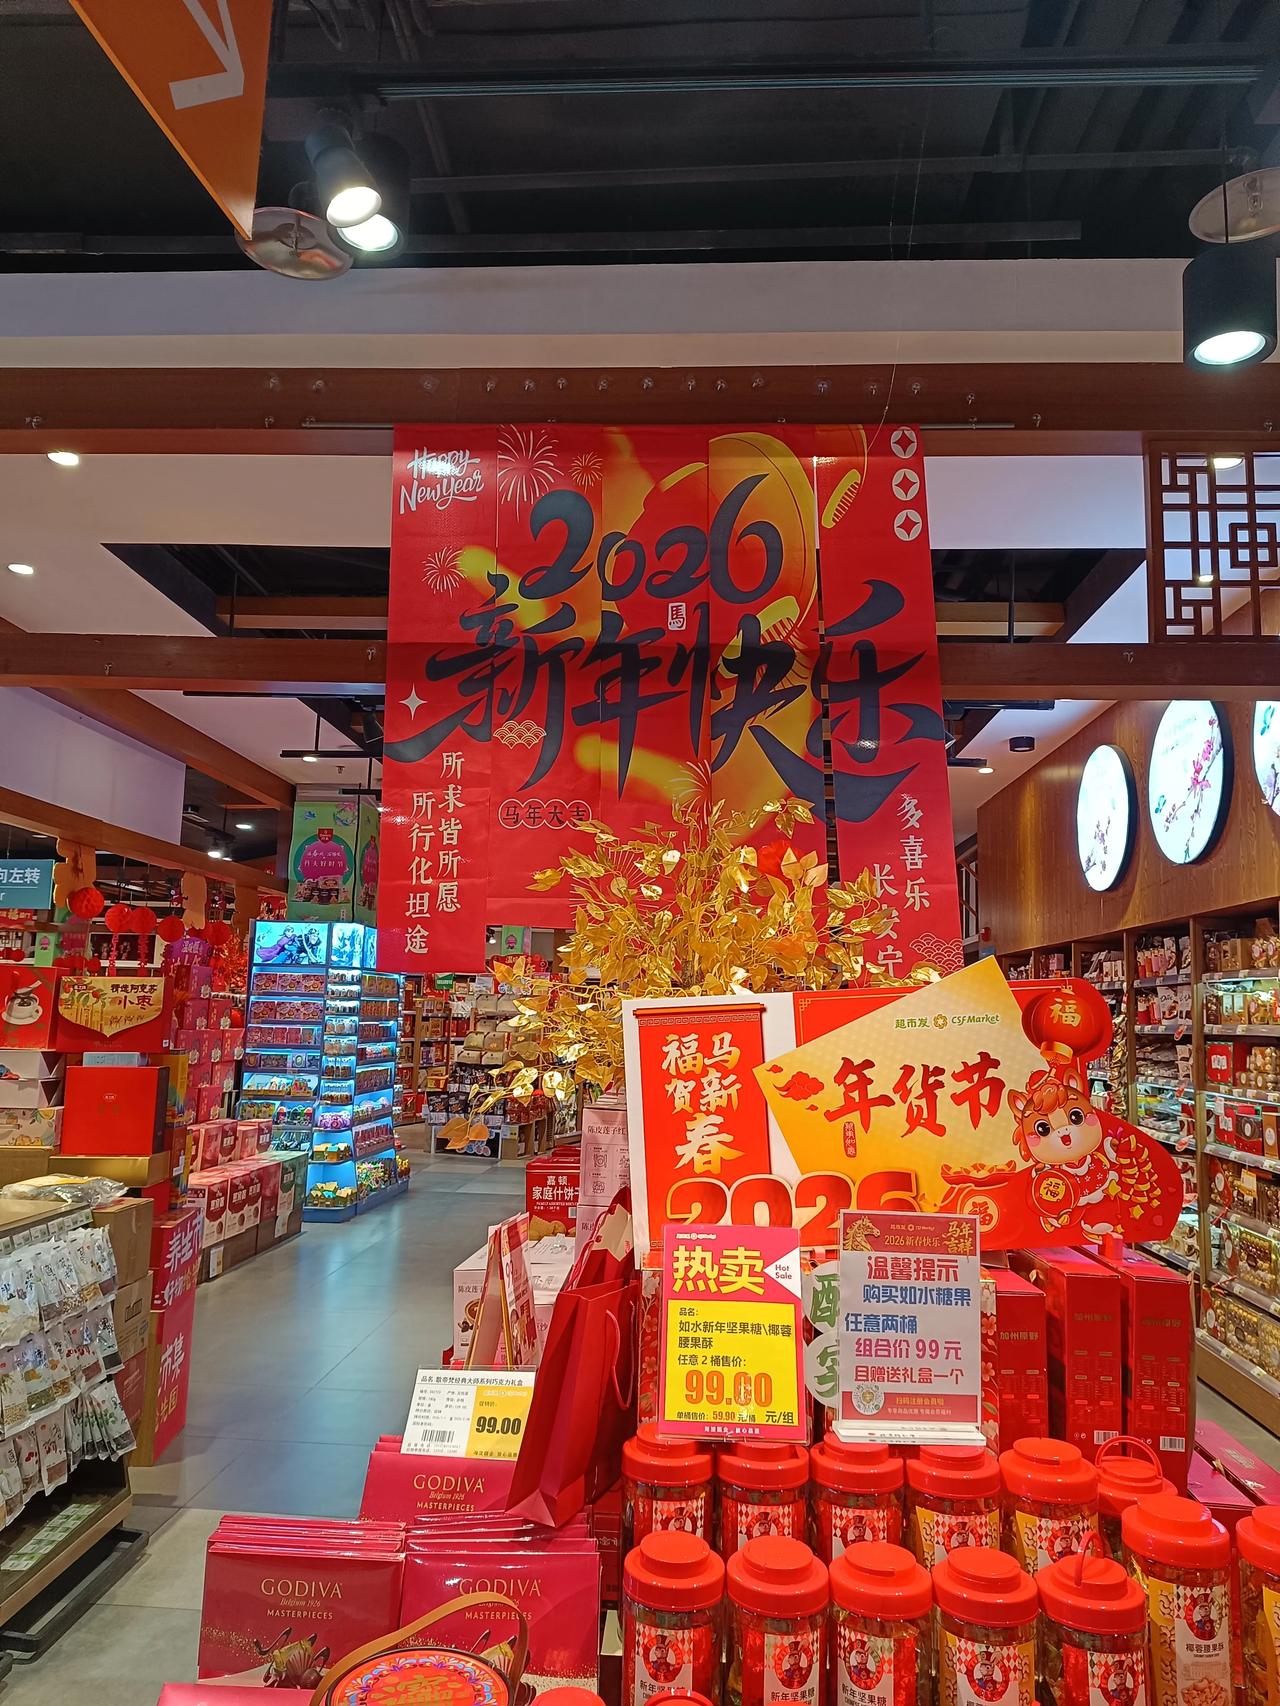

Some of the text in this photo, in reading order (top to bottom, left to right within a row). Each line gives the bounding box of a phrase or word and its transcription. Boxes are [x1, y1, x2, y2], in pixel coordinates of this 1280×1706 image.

[407, 446, 481, 480] Happy
[400, 469, 485, 515] New Year
[518, 473, 784, 604] 2026
[668, 603, 686, 630] 馬
[384, 570, 945, 823] 新年快乐
[502, 803, 591, 827] 马年大吉
[436, 751, 467, 913] 所求皆所愿
[897, 793, 931, 912] 多喜乐
[0, 867, 40, 884] 向左转
[404, 791, 437, 955] 所行化坦途
[895, 1017, 931, 1029] 超市发
[1049, 998, 1083, 1028] 福
[661, 1031, 742, 1076] 福马
[664, 1068, 744, 1115] 贺新
[824, 1051, 1007, 1139] 年货节
[674, 1112, 746, 1175] 春
[1043, 1180, 1060, 1199] 福
[943, 1221, 973, 1238] 马年
[943, 1237, 974, 1254] 吉祥
[672, 1244, 766, 1295] 热卖
[775, 1264, 790, 1272] Hot
[775, 1272, 792, 1280] Sale
[867, 1255, 959, 1282] 温馨提示
[862, 1284, 972, 1307] 购买如水糖果
[678, 1319, 792, 1338] 如水新年坚果糖\椰蓉
[844, 1312, 919, 1335] 任意两桶
[678, 1336, 714, 1350] 腰果酥
[855, 1337, 962, 1361] 组合价 99 元
[677, 1354, 747, 1368] 任意 2 桶售价：
[854, 1365, 965, 1385] 且赠送礼盒一个
[685, 1369, 773, 1408] 99.00
[475, 1416, 522, 1436] 99.00
[712, 1410, 736, 1421] 59.90
[765, 1410, 794, 1424] 元/组
[413, 1474, 484, 1494] GODIVA
[416, 1501, 475, 1512] MASTERPIECES
[429, 1491, 452, 1501] Belgium
[261, 1578, 342, 1599] GODIVA
[459, 1578, 541, 1597] GODIVA
[307, 1599, 321, 1608] 1926
[267, 1609, 333, 1620] MASTERPIECES
[771, 1686, 816, 1701] 新年坚果糖
[841, 1683, 888, 1706] 新年坚果糖
